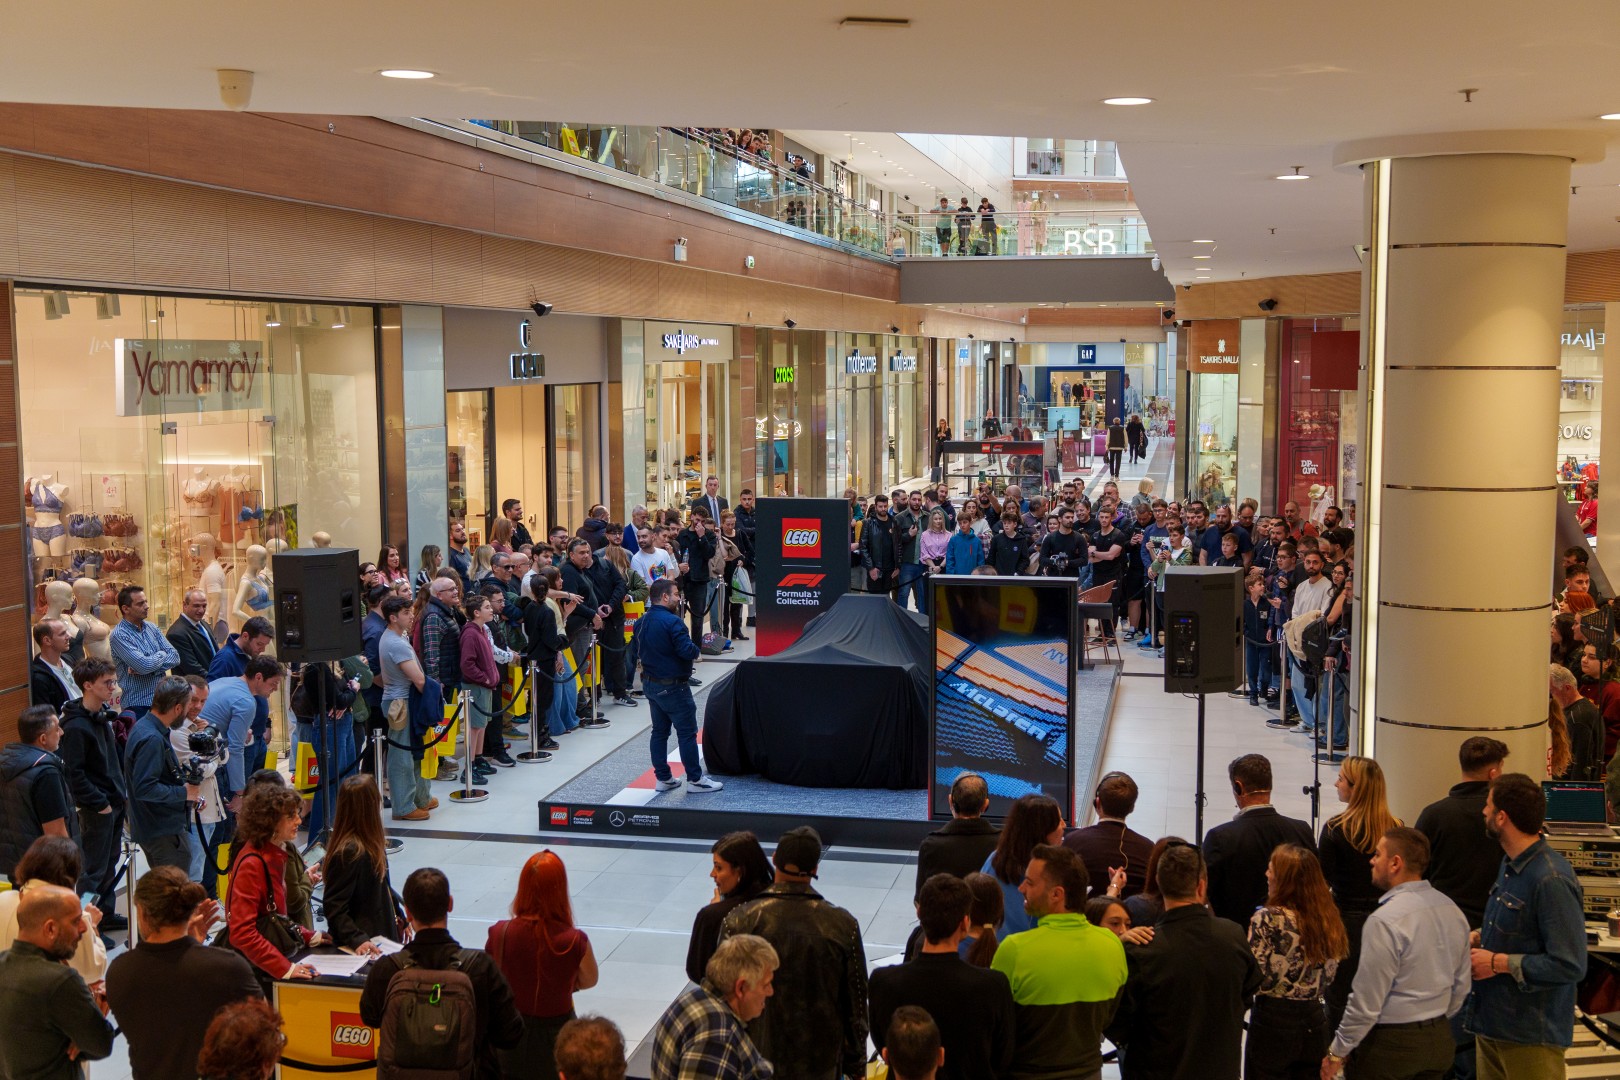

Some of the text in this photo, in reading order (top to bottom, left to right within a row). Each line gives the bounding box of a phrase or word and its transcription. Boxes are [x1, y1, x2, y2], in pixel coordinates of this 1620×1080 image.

[1064, 229, 1116, 255] BSB
[846, 350, 877, 374] mothercare
[892, 351, 916, 372] mothercare
[1081, 349, 1094, 360] GAP
[775, 367, 794, 383] crocs
[784, 529, 821, 547] LEGO
[776, 589, 812, 598] Formula
[776, 597, 820, 606] Collection
[949, 682, 1047, 742] McLaren
[551, 811, 568, 820] LEGO
[334, 1025, 372, 1047] LEGO
